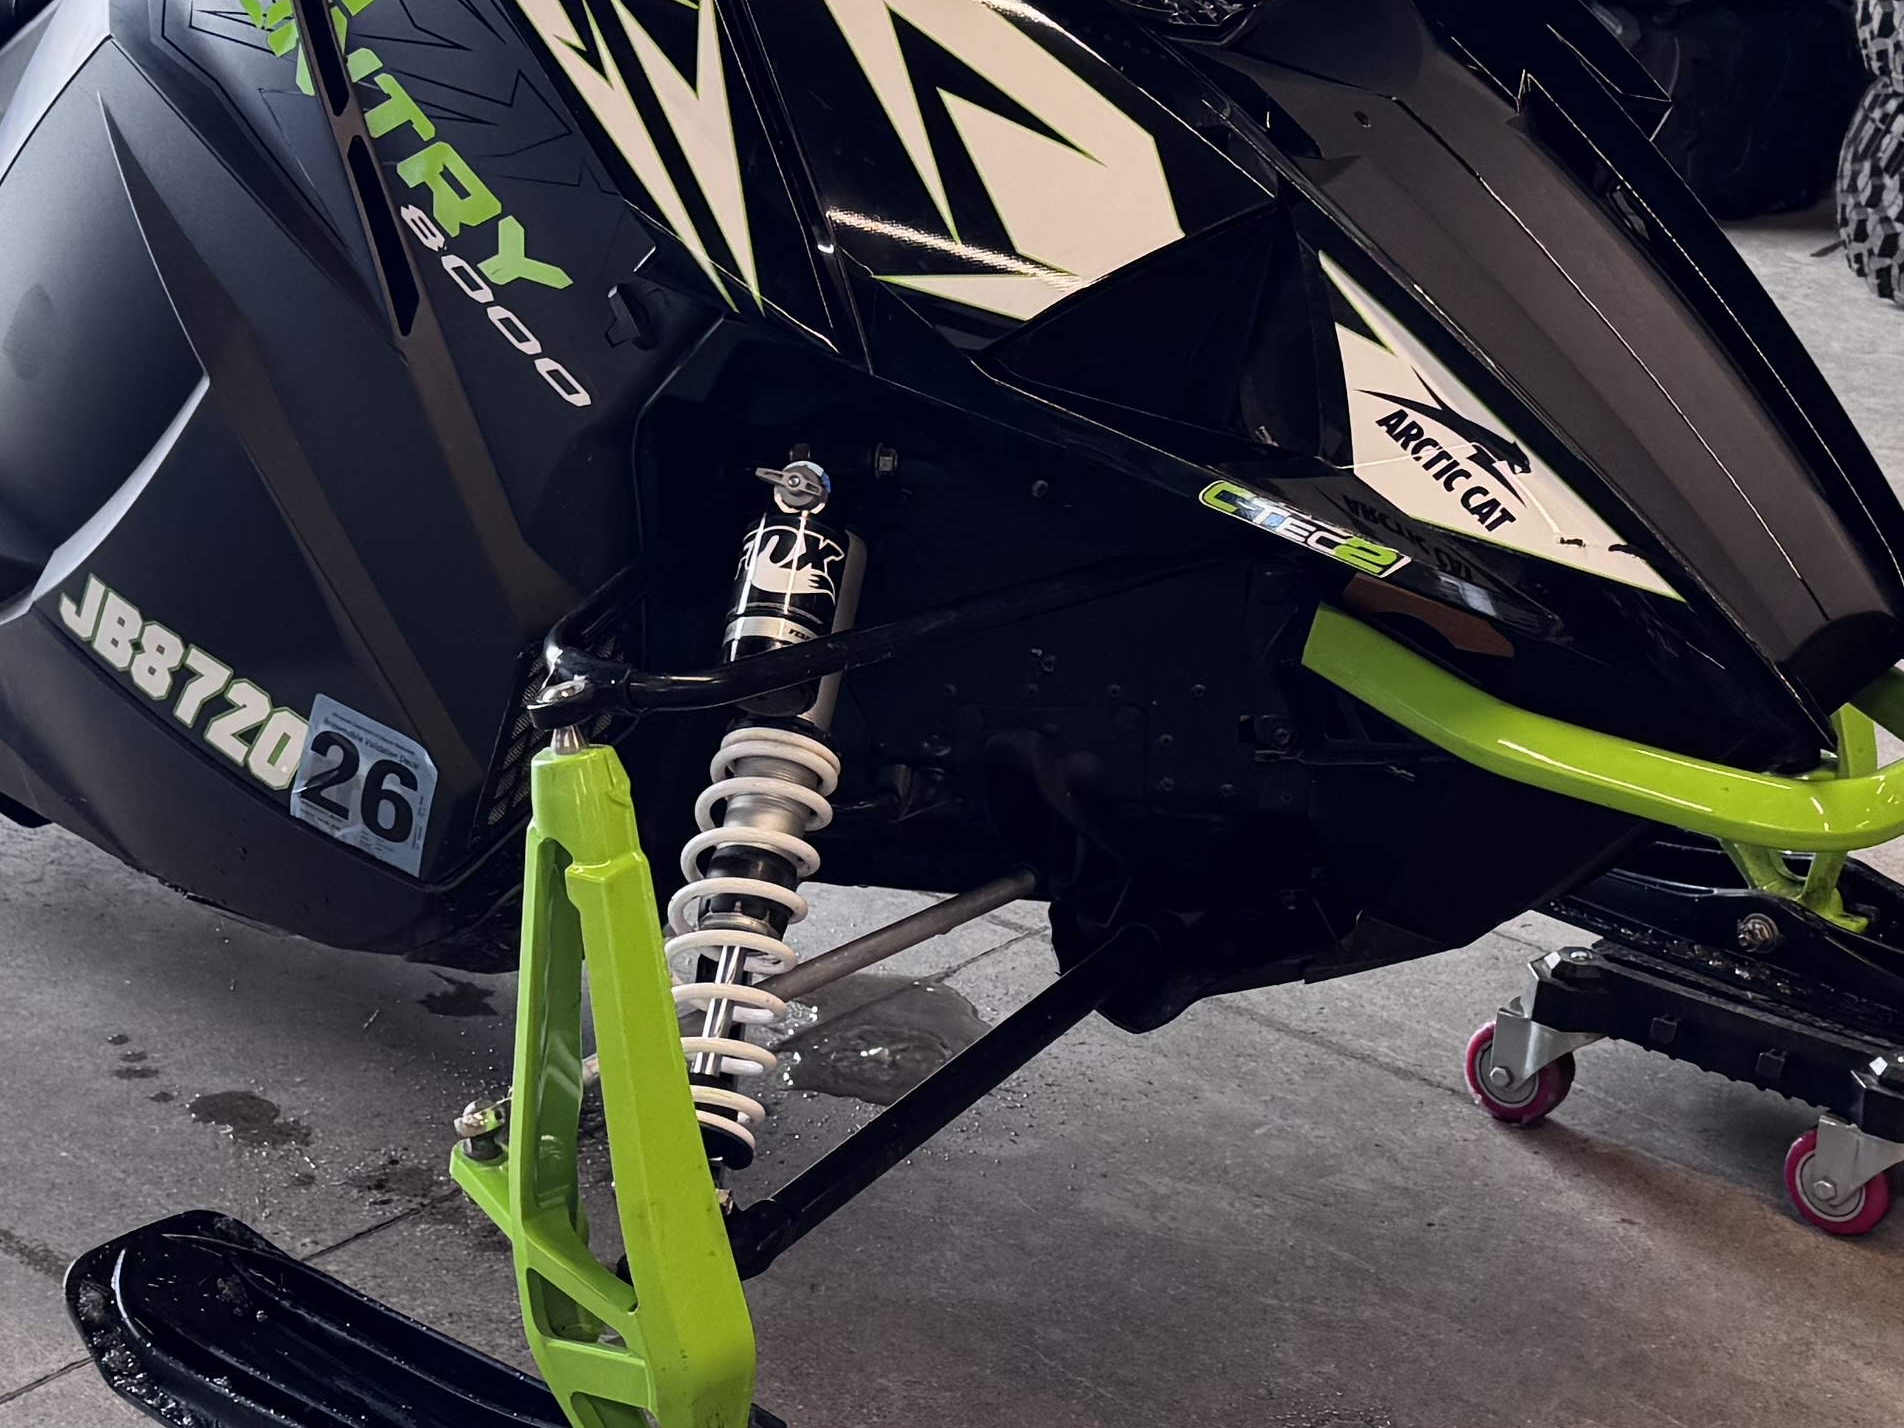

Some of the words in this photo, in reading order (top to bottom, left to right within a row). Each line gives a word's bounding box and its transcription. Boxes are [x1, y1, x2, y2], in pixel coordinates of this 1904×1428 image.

[399, 202, 593, 408] 8000
[1375, 409, 1471, 495] ARCTIC
[1460, 484, 1517, 533] CAT
[59, 572, 310, 791] JB8720
[298, 730, 422, 844] 26
